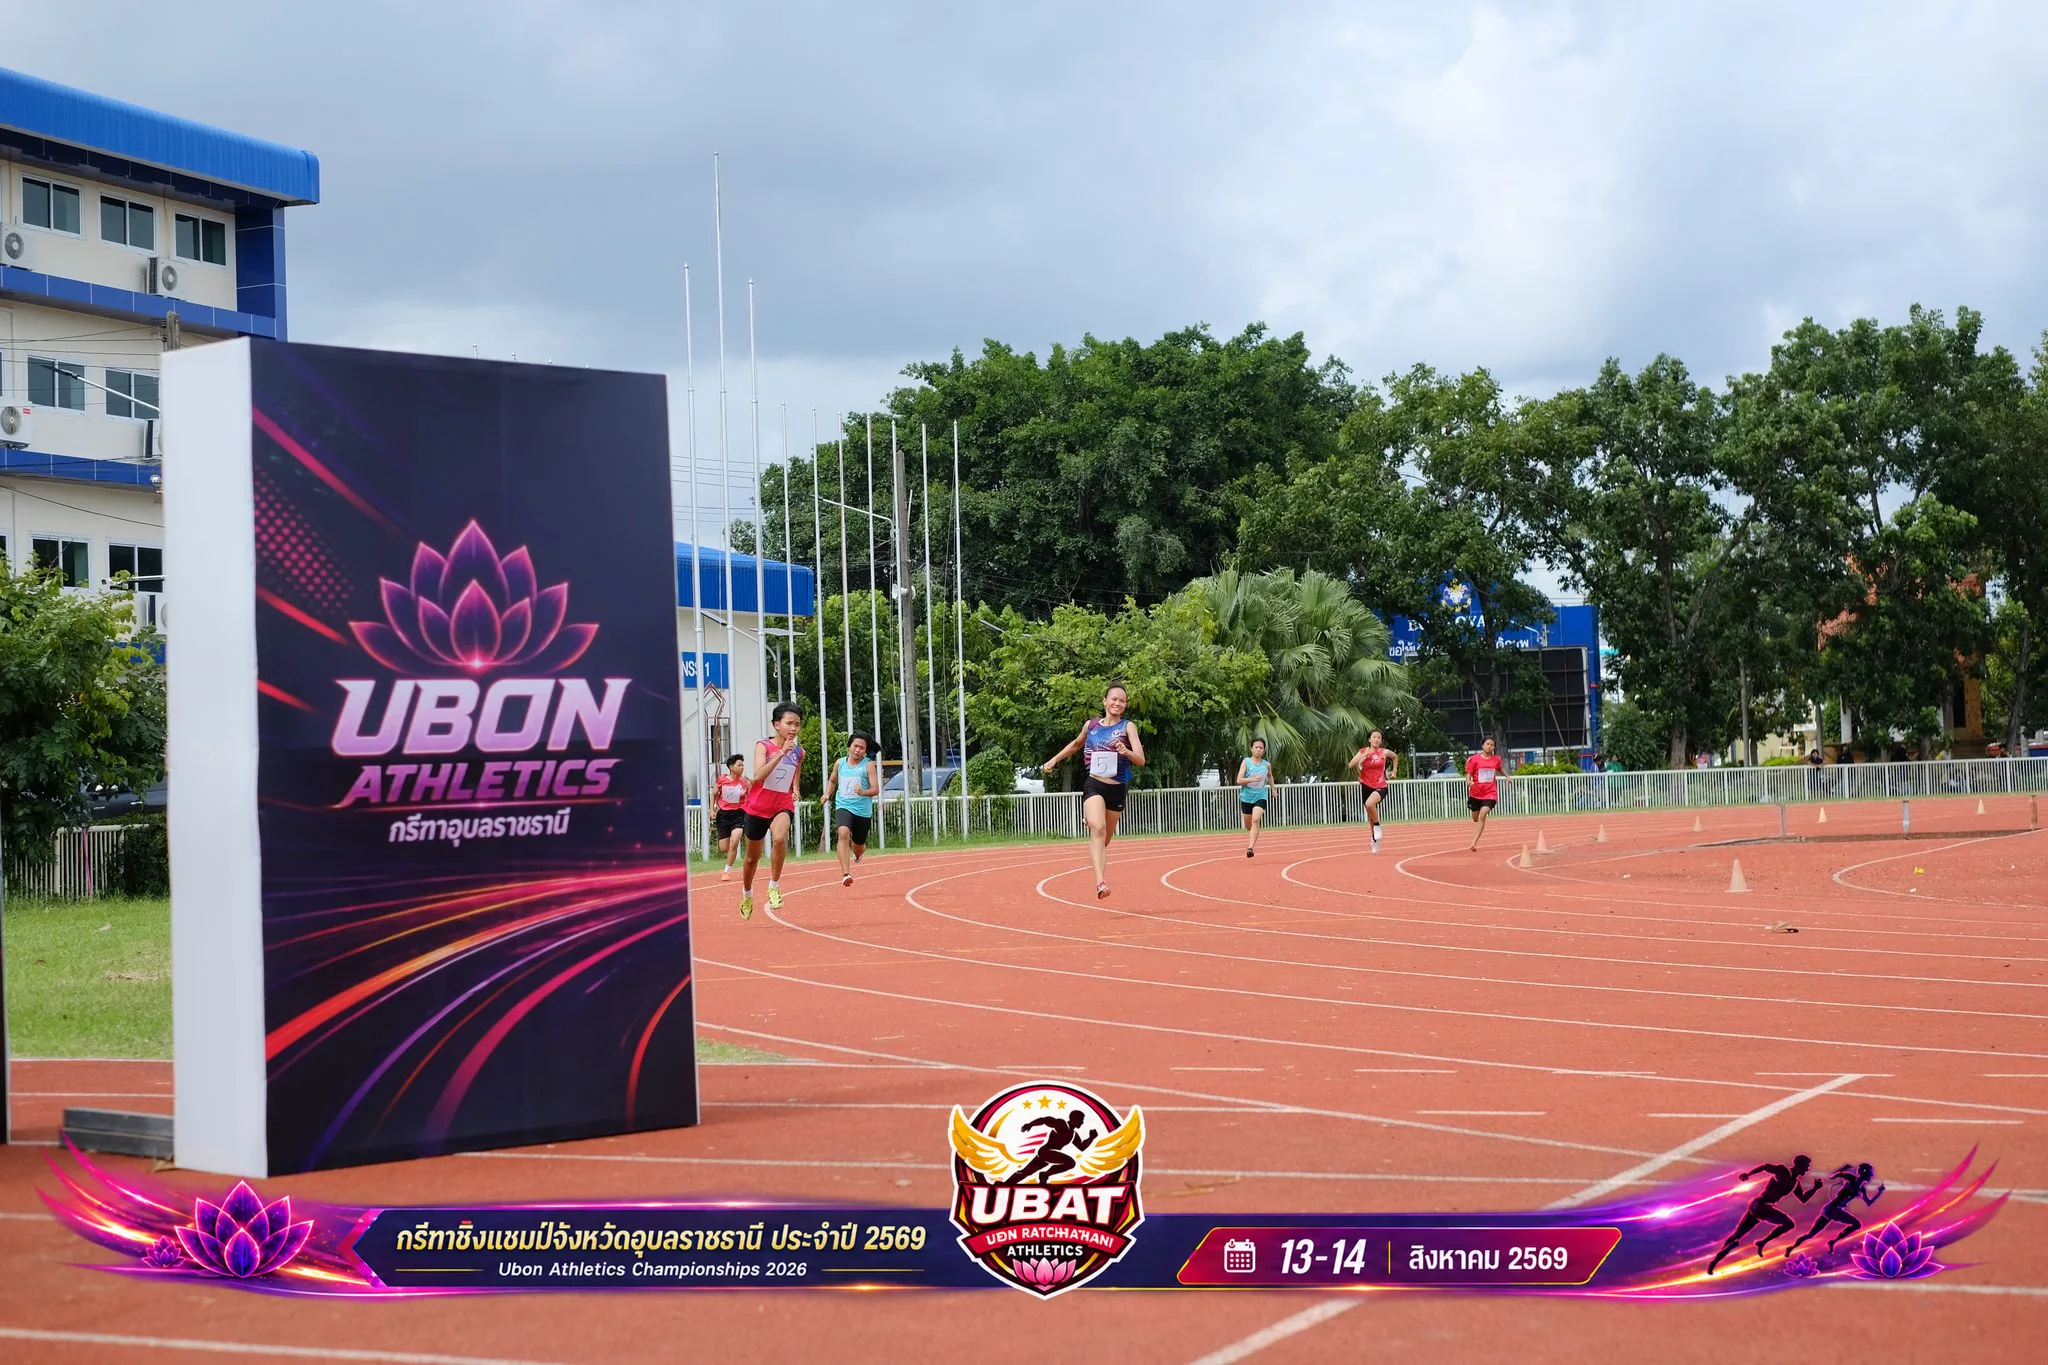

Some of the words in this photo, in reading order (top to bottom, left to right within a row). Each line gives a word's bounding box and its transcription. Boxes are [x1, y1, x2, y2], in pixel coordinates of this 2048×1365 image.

[332, 678, 632, 756] UBON
[332, 758, 623, 807] ATHLETICS
[775, 768, 788, 785] 7
[1097, 757, 1108, 775] 5
